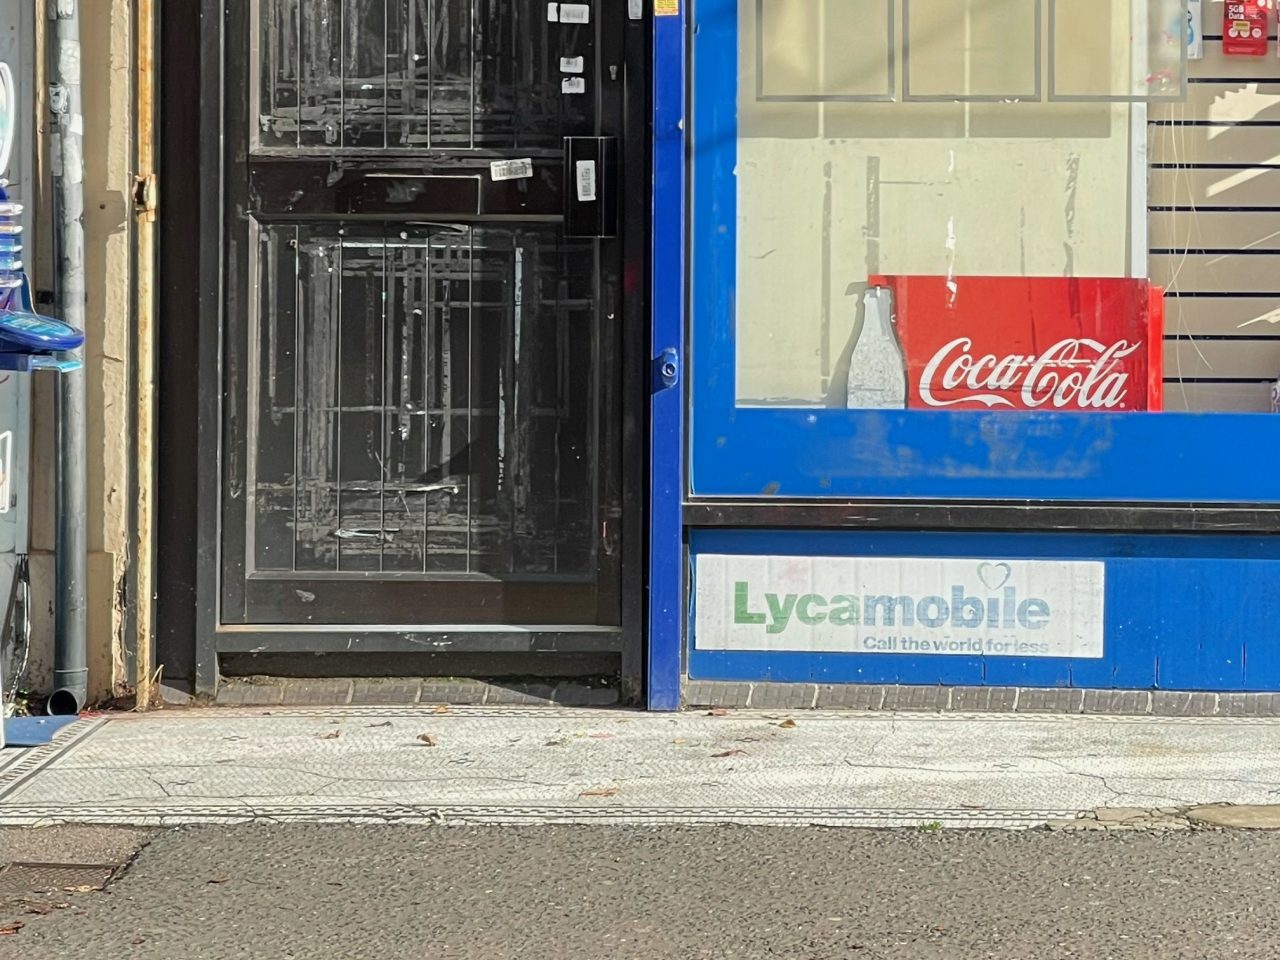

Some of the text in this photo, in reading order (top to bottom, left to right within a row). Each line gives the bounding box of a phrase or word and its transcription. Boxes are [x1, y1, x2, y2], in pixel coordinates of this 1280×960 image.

[1228, 5, 1244, 13] 5GB
[734, 581, 1050, 634] Lycamobile
[863, 635, 1049, 654] Call the world for less
